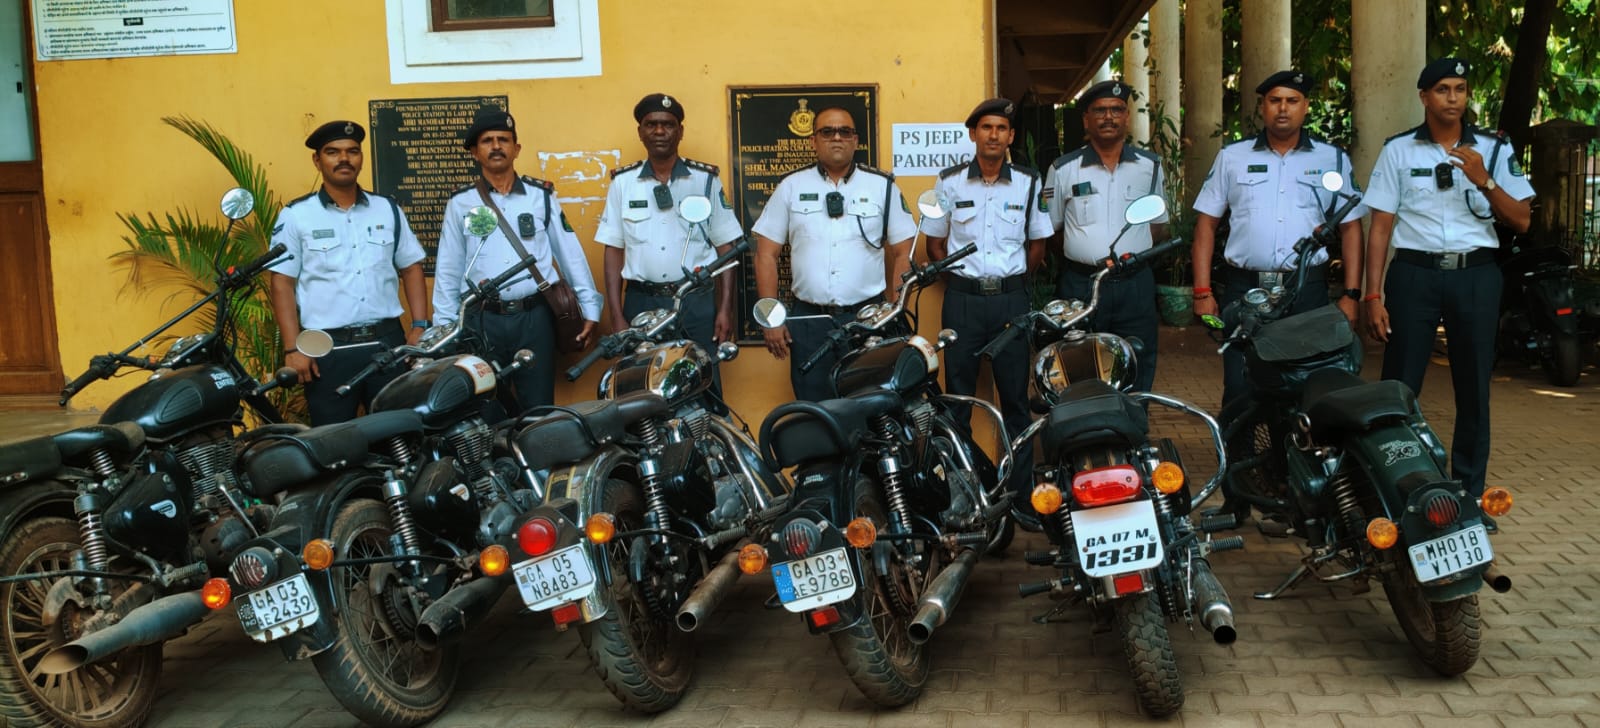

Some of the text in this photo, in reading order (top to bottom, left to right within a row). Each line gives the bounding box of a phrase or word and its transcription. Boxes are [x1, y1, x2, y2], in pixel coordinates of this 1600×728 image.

[900, 130, 963, 148] PS JEEP
[1086, 528, 1149, 547] GA 07 M
[526, 554, 571, 582] GA 05
[792, 555, 836, 578] GA 03
[1086, 542, 1157, 570] 1331
[1432, 547, 1483, 576] V1130
[254, 581, 298, 609] GA 03
[532, 571, 578, 600] N8483
